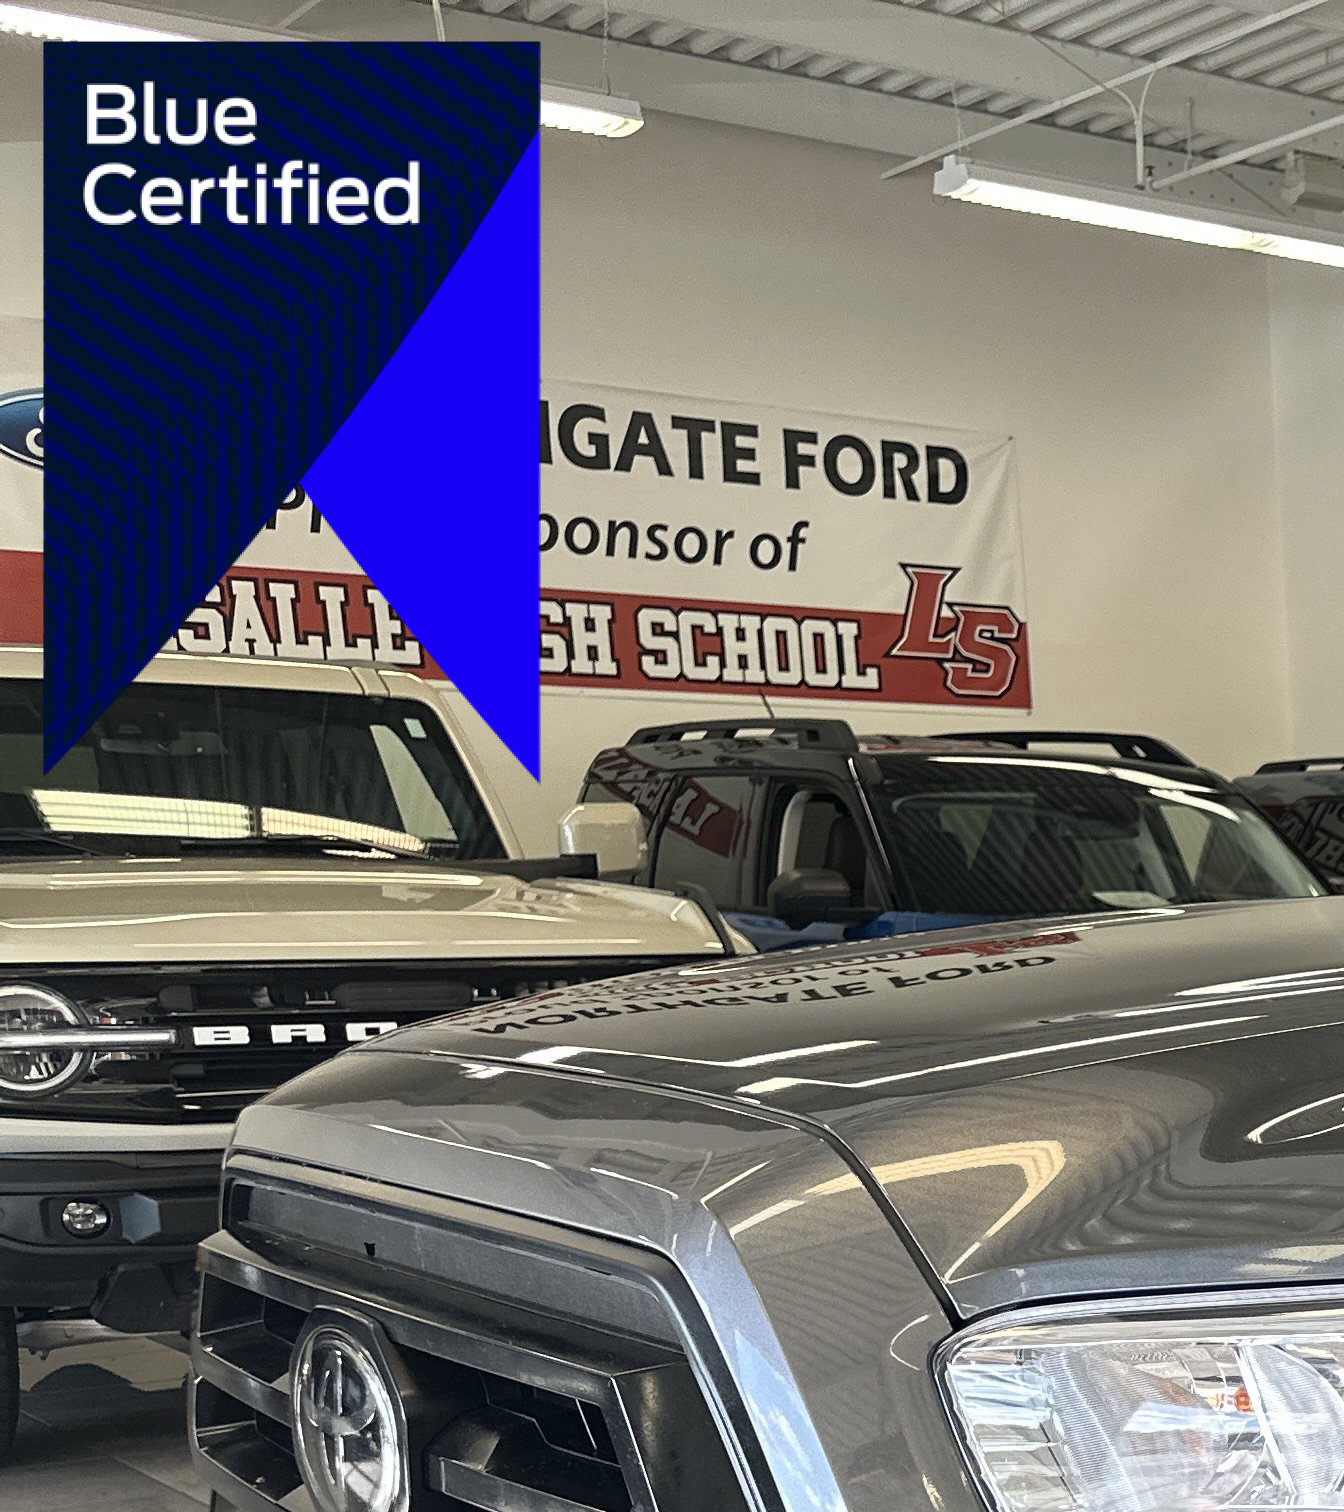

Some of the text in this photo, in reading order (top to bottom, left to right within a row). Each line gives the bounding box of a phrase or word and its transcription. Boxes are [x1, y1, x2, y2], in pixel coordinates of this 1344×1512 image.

[540, 399, 970, 506] GATE FORD
[749, 519, 810, 573] of
[168, 576, 426, 668] SALLE
[634, 604, 882, 693] SCHOOL
[193, 1021, 398, 1046] BRO
